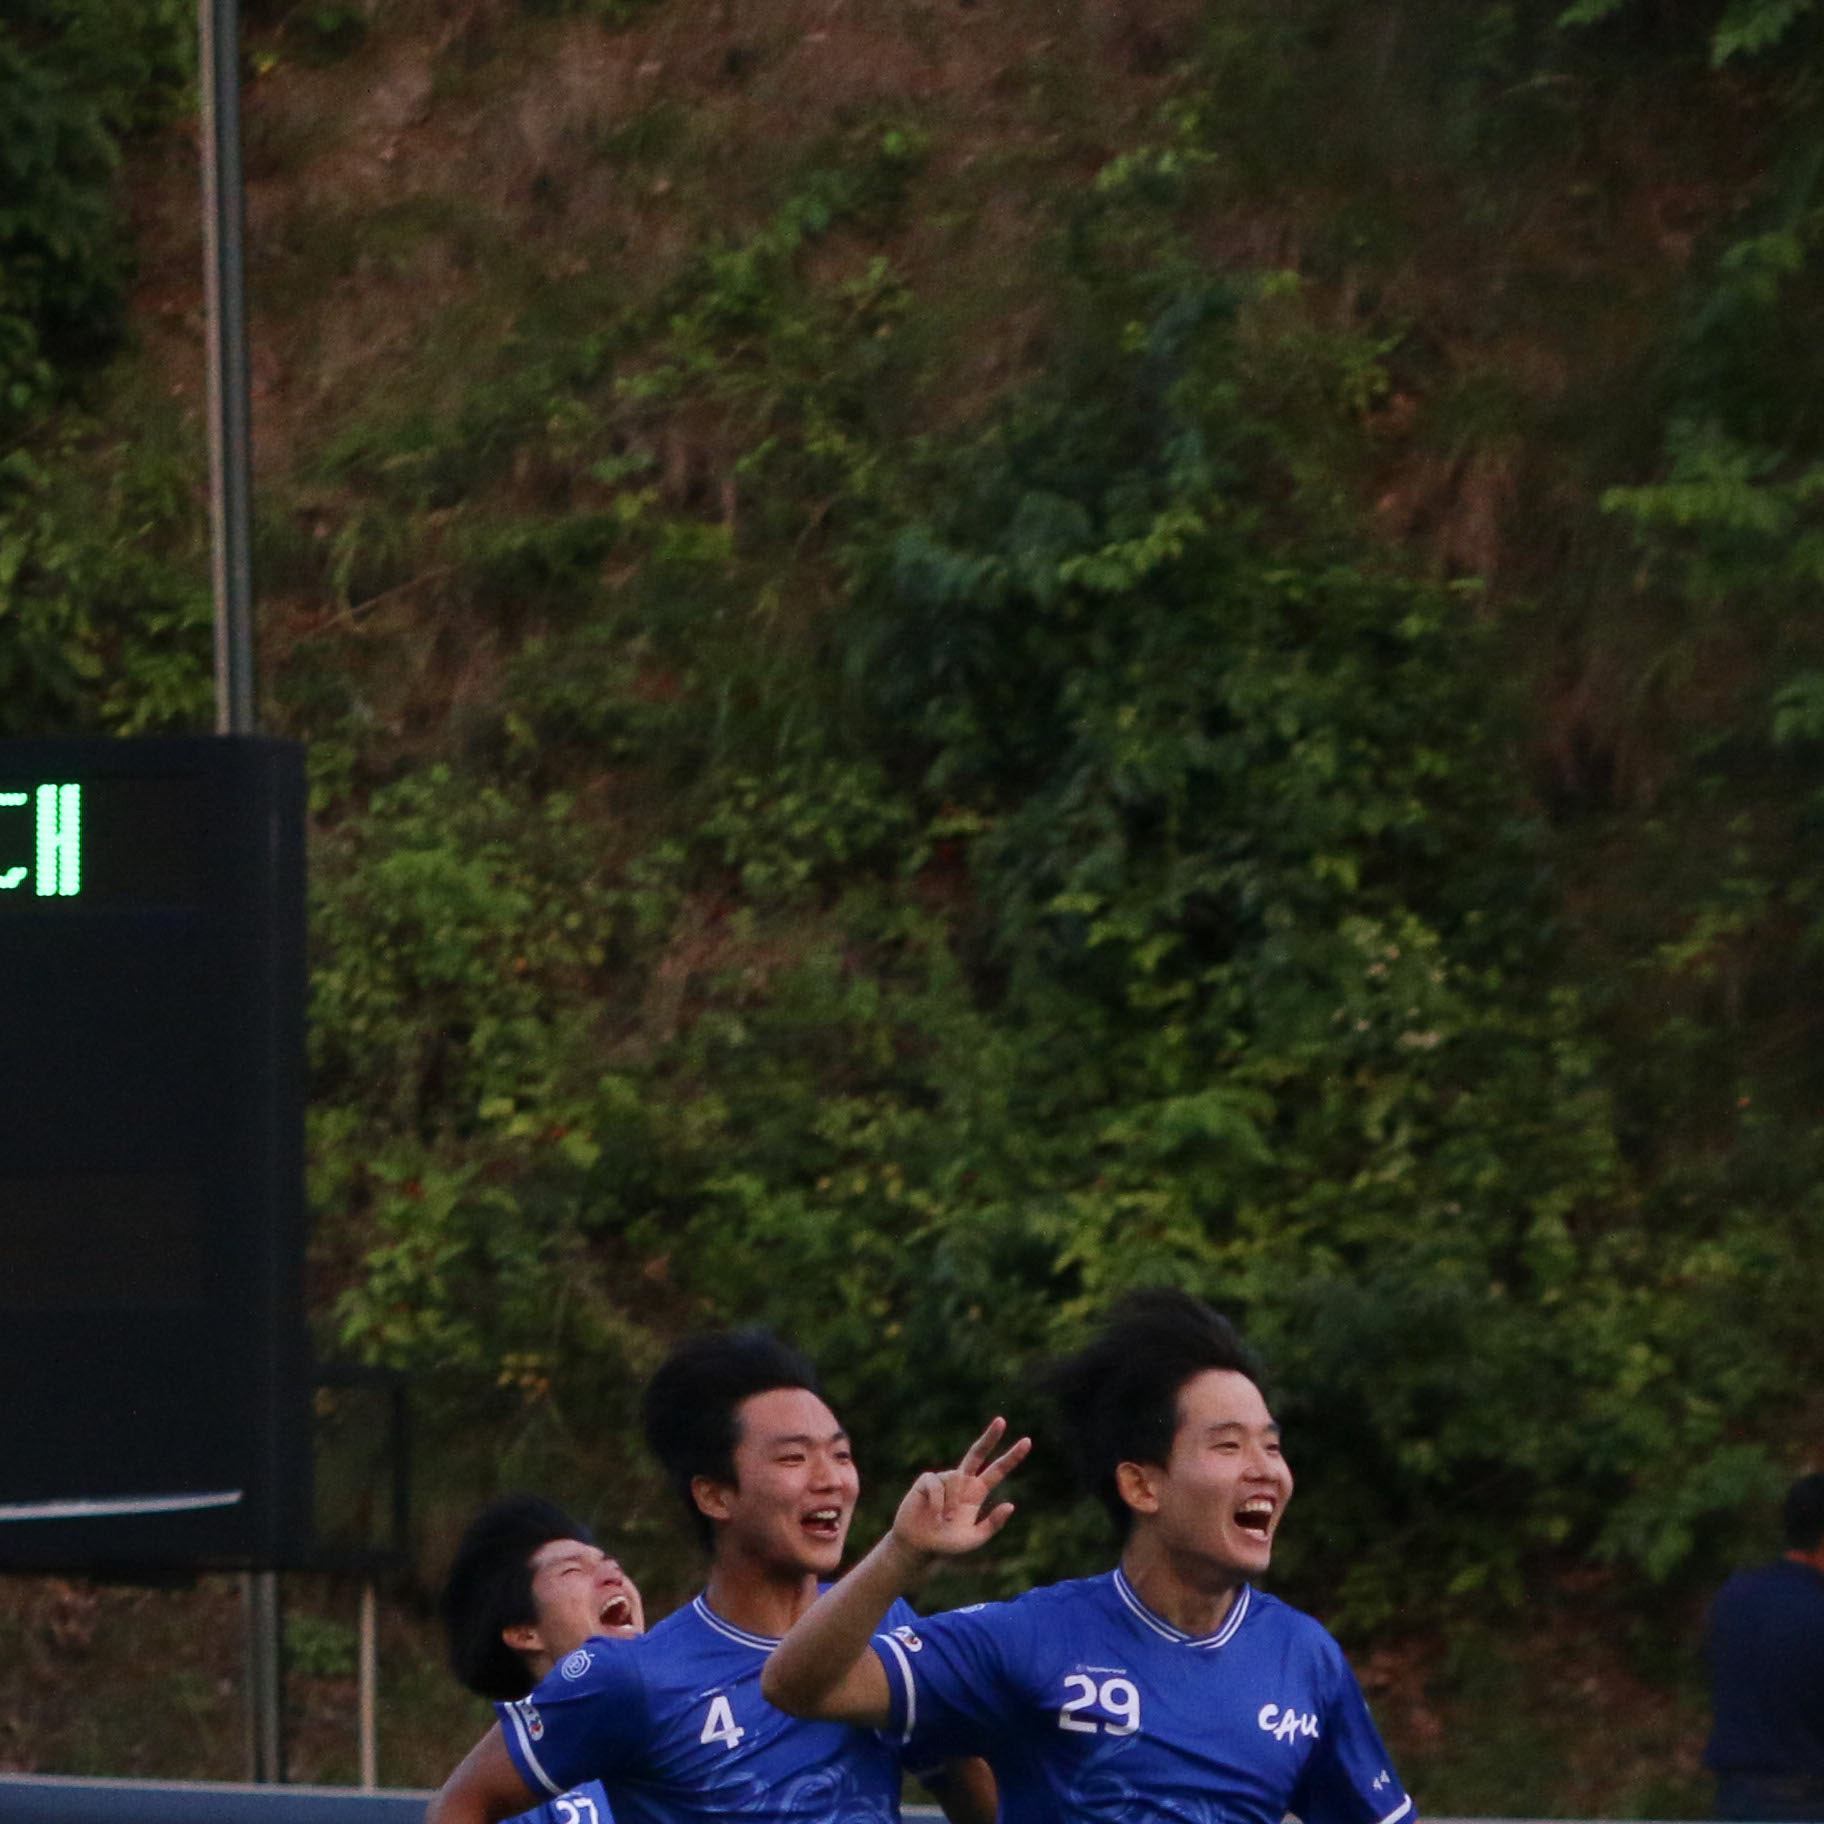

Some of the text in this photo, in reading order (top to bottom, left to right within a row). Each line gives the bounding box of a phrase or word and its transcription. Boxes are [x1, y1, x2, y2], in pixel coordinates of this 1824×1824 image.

[701, 1693, 745, 1749] 4
[1060, 1670, 1140, 1736] 29
[1258, 1703, 1319, 1745] CAU
